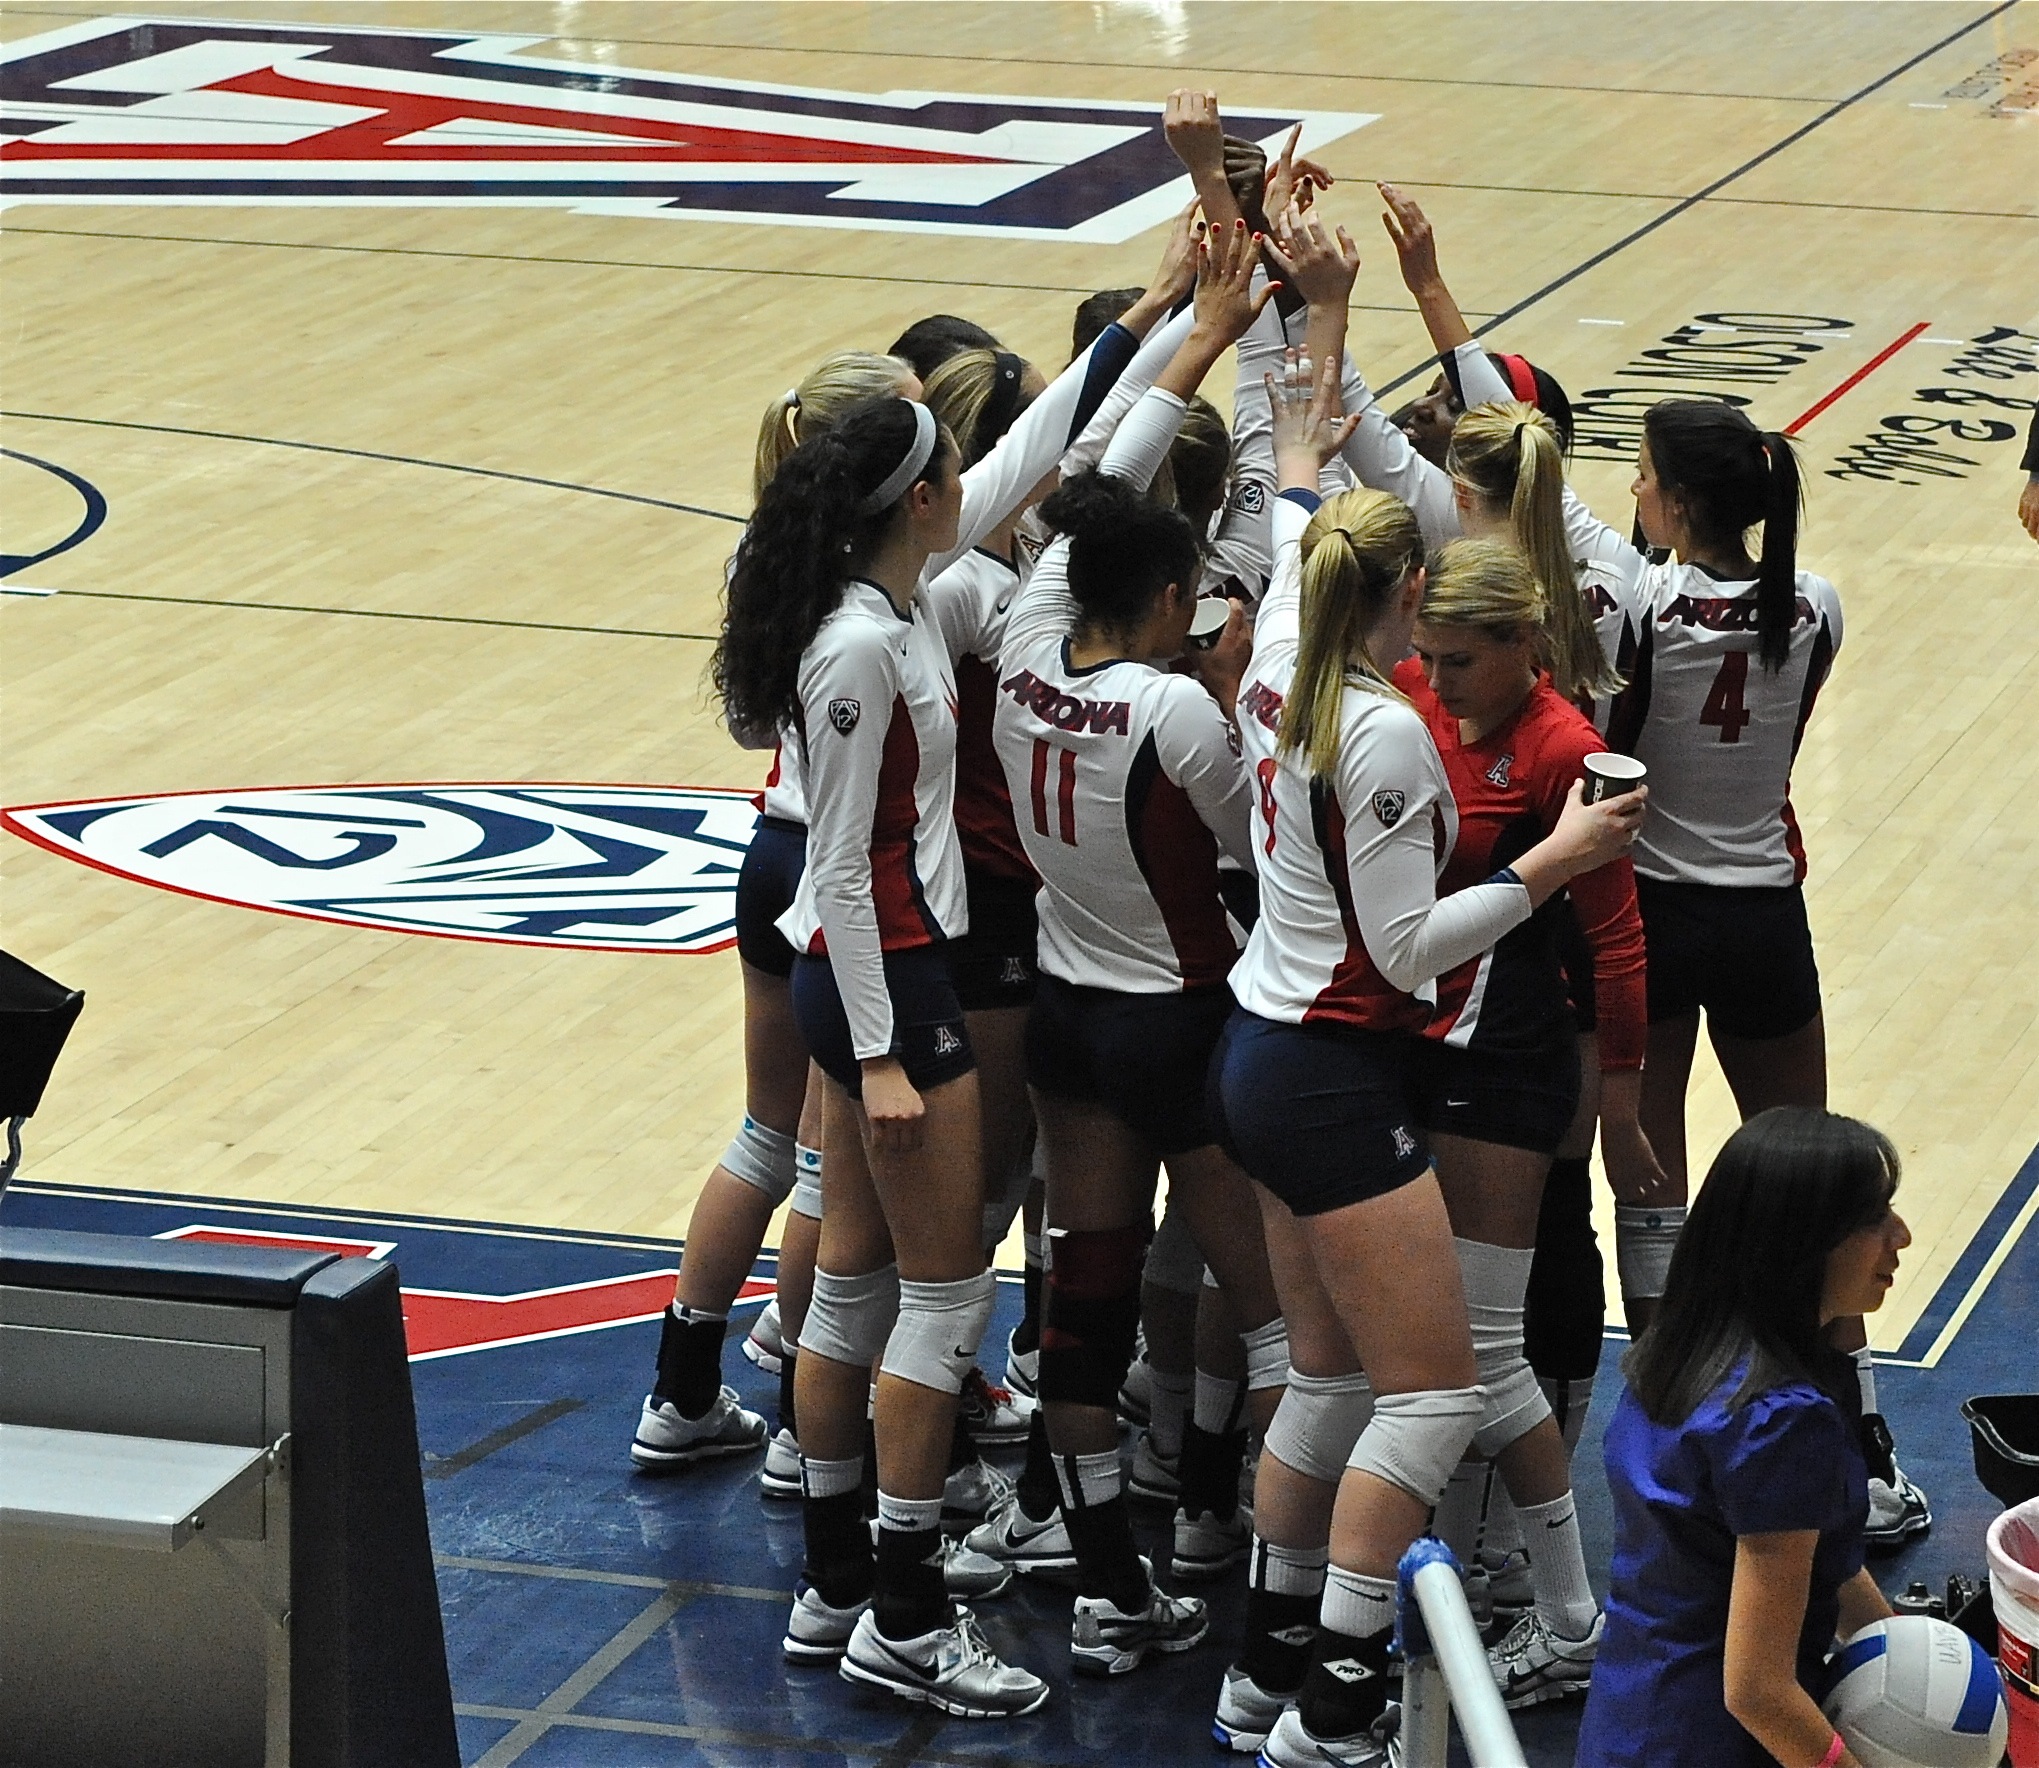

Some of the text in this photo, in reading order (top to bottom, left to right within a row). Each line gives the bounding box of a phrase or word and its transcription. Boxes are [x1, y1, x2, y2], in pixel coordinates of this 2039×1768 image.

[1614, 313, 1855, 384] OLSON
[1824, 415, 2016, 486] Bobbi
[830, 700, 859, 722] PAC
[1700, 651, 1749, 743] 4
[836, 714, 852, 729] 12
[1485, 754, 1514, 788] A
[1030, 739, 1078, 847] 11
[1374, 791, 1403, 814] PAC
[1381, 806, 1398, 821] 12
[934, 1026, 962, 1056] A
[1390, 1126, 1417, 1161] A
